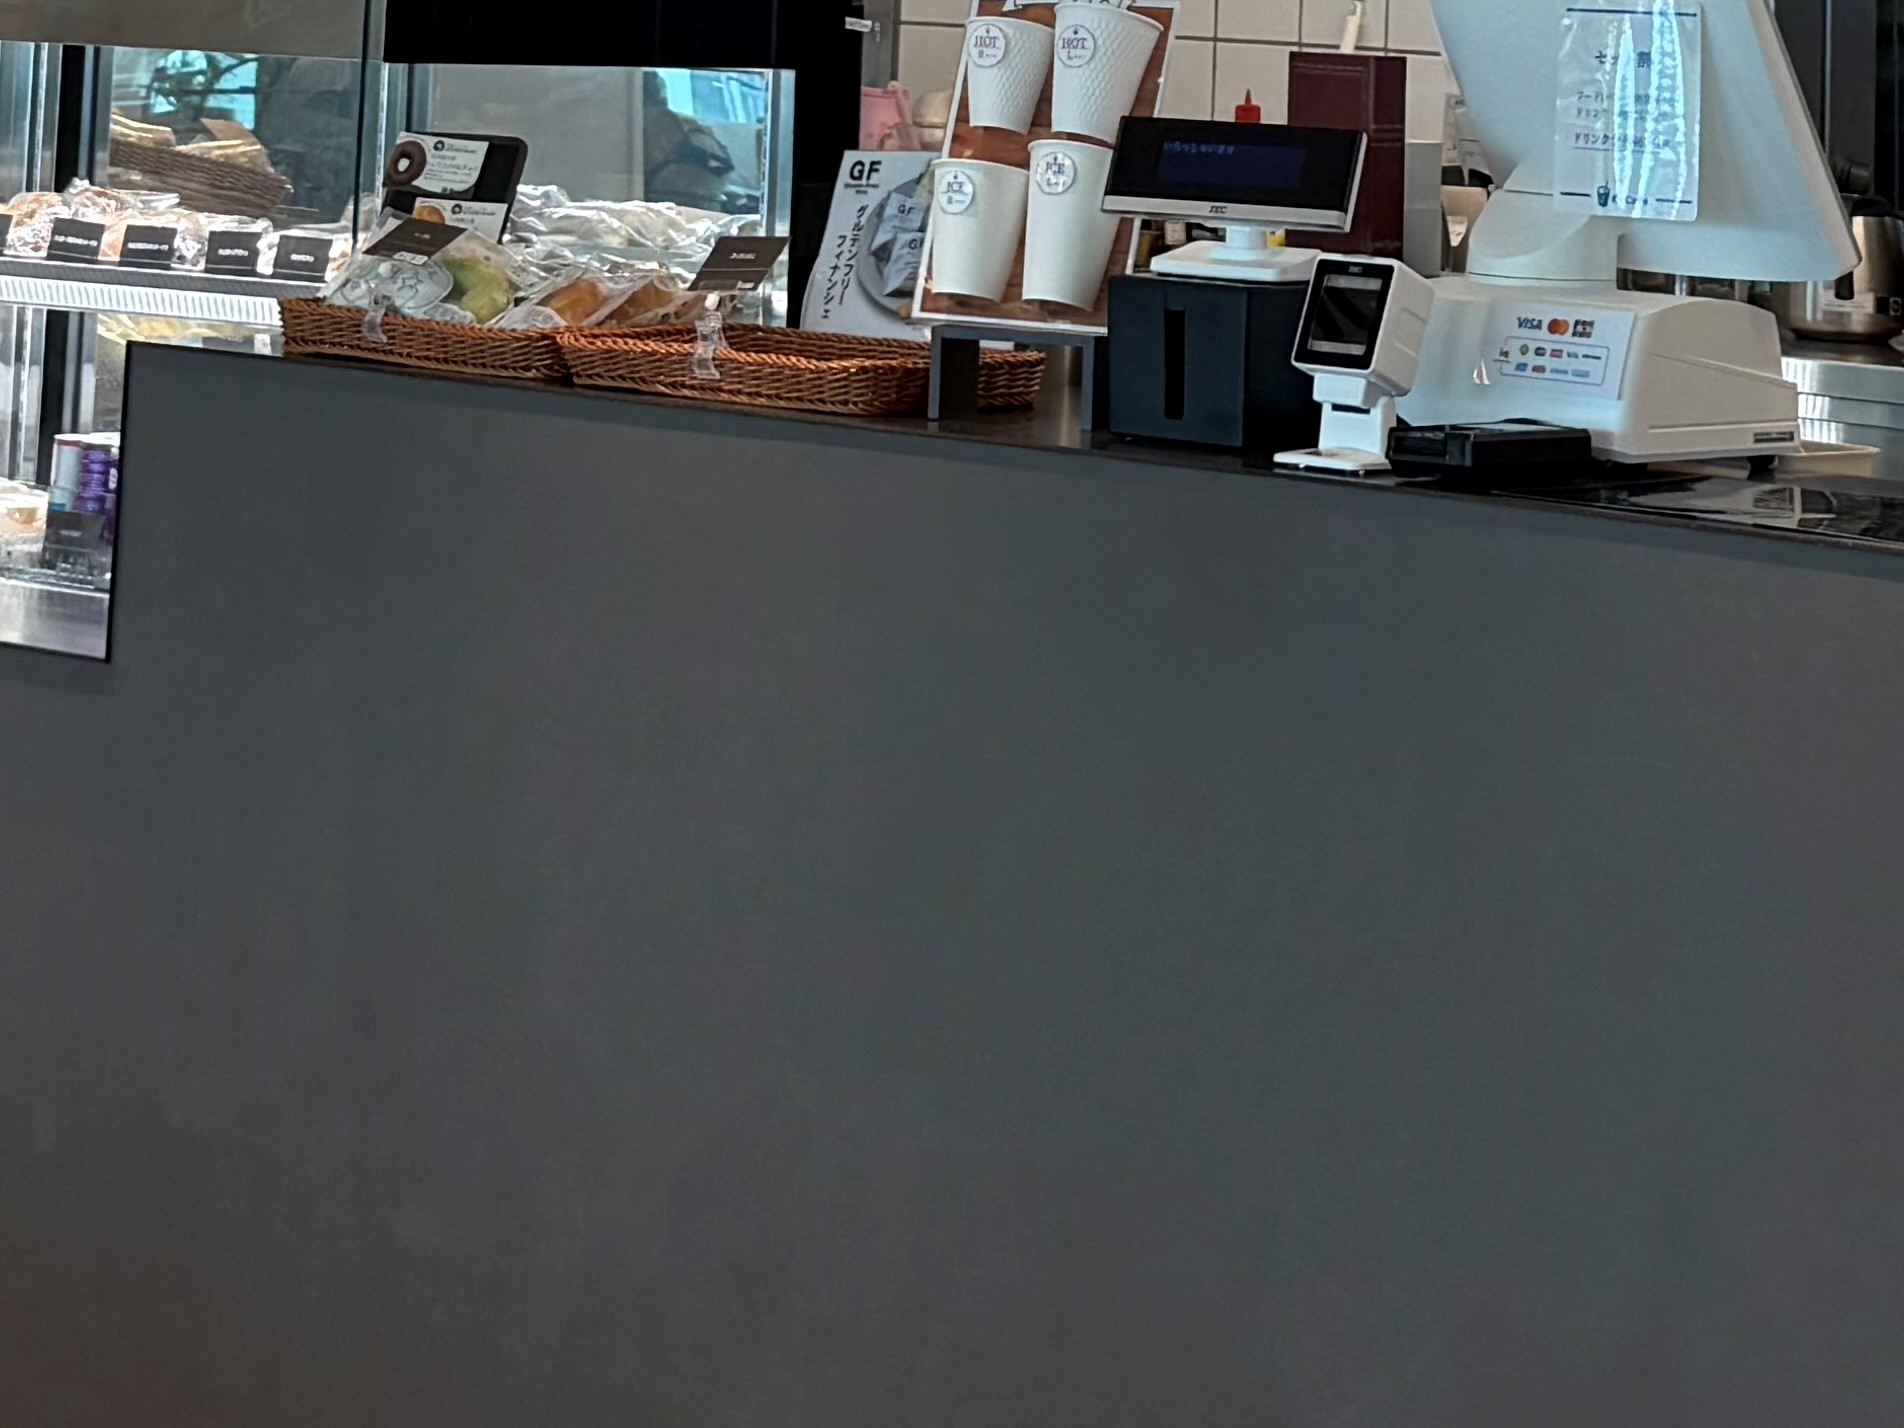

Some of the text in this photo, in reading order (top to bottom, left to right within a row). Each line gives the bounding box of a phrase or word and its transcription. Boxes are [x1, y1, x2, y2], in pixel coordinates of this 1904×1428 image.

[849, 160, 882, 182] GF
[897, 204, 916, 216] GF
[839, 204, 869, 306] グルテンフリー
[821, 235, 847, 319] フィナンシェ
[1517, 317, 1542, 330] VISA
